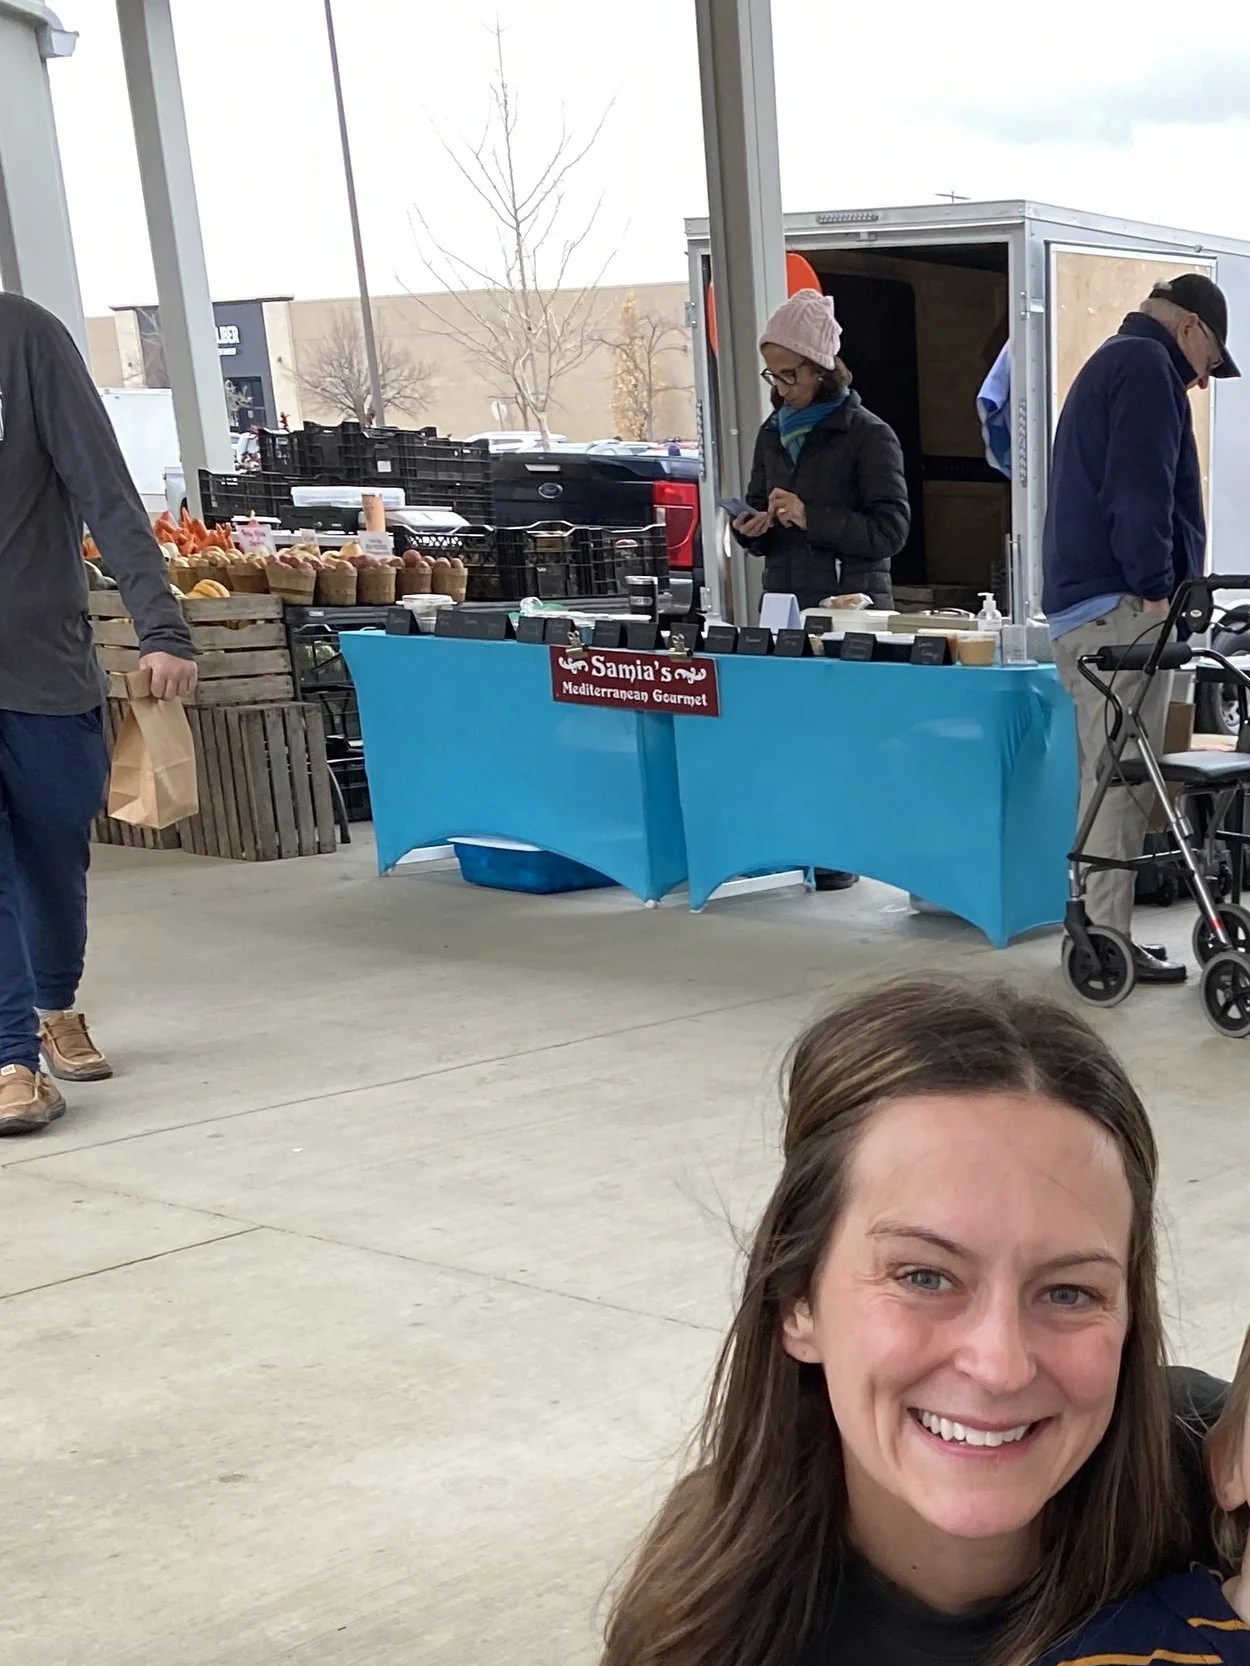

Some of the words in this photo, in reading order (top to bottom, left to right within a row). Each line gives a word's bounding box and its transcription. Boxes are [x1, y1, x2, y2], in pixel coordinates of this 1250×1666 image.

[591, 655, 672, 684] Samia's
[562, 681, 648, 703] Mediterranean
[652, 689, 708, 707] Gourmet
